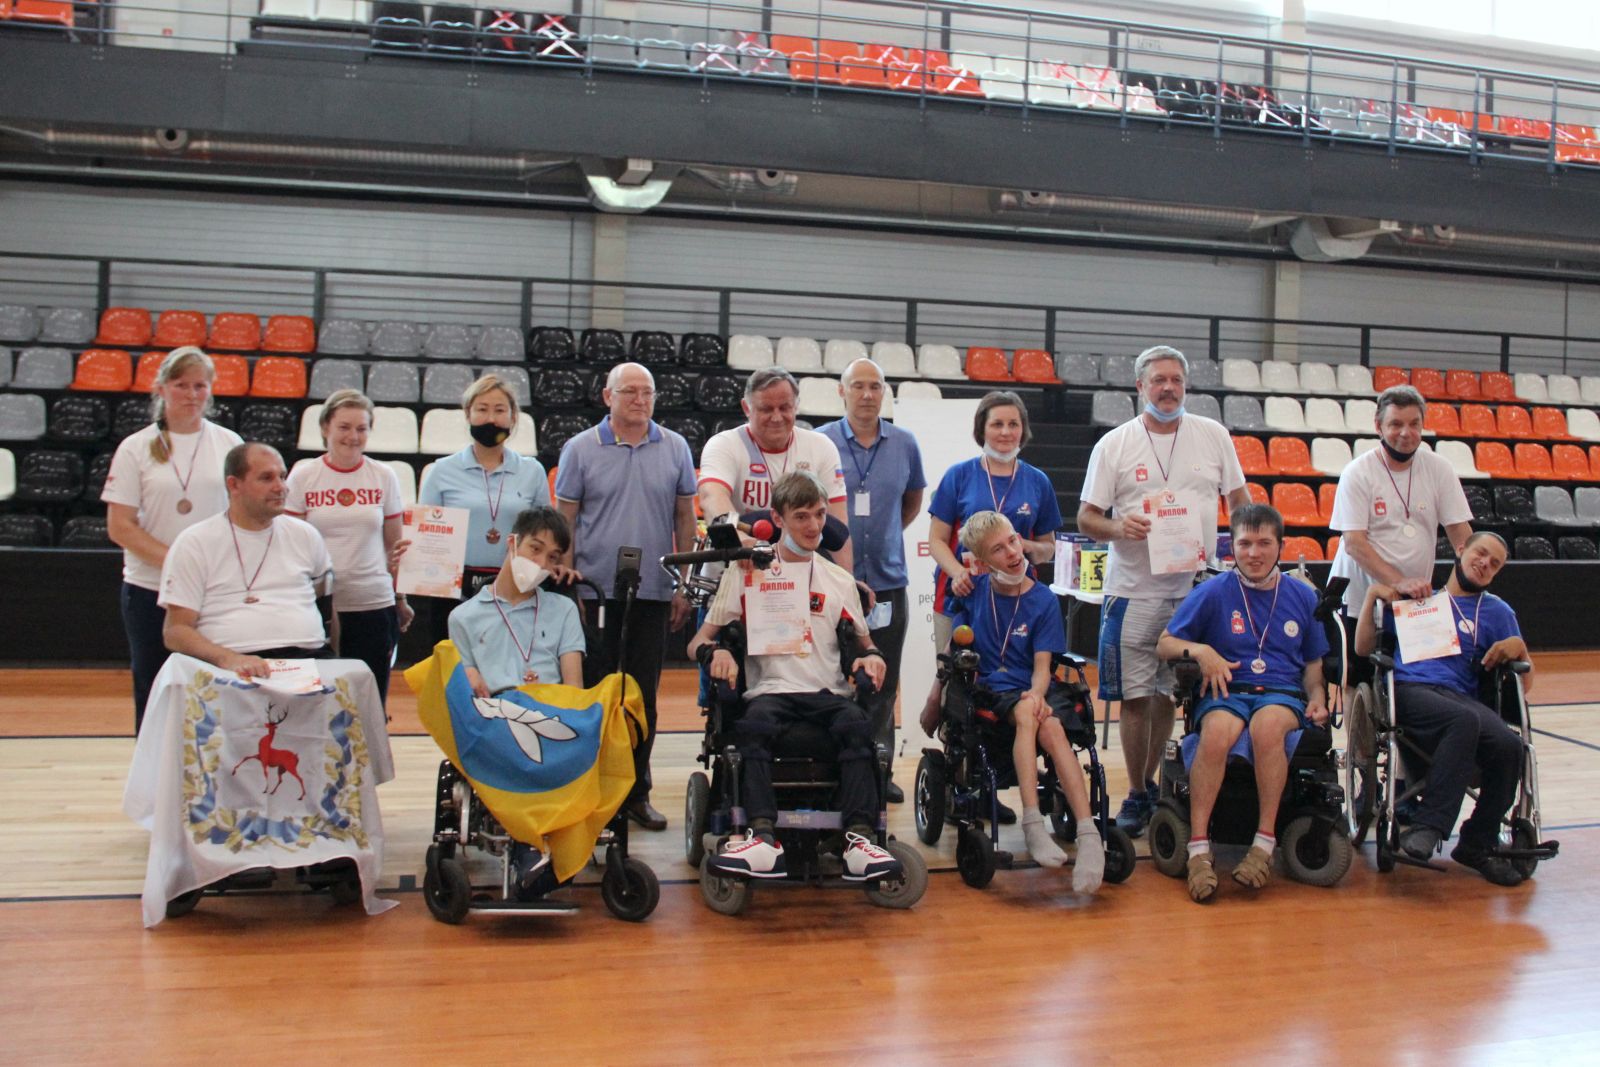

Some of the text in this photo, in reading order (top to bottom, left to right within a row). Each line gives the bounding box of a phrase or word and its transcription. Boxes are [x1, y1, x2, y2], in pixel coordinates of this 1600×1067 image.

[1157, 507, 1188, 518] ДИПЛОМ
[418, 523, 454, 535] ДИПЛОМ
[760, 581, 795, 593] ДИПЛОМ
[1408, 607, 1438, 618] ДИПЛОМ
